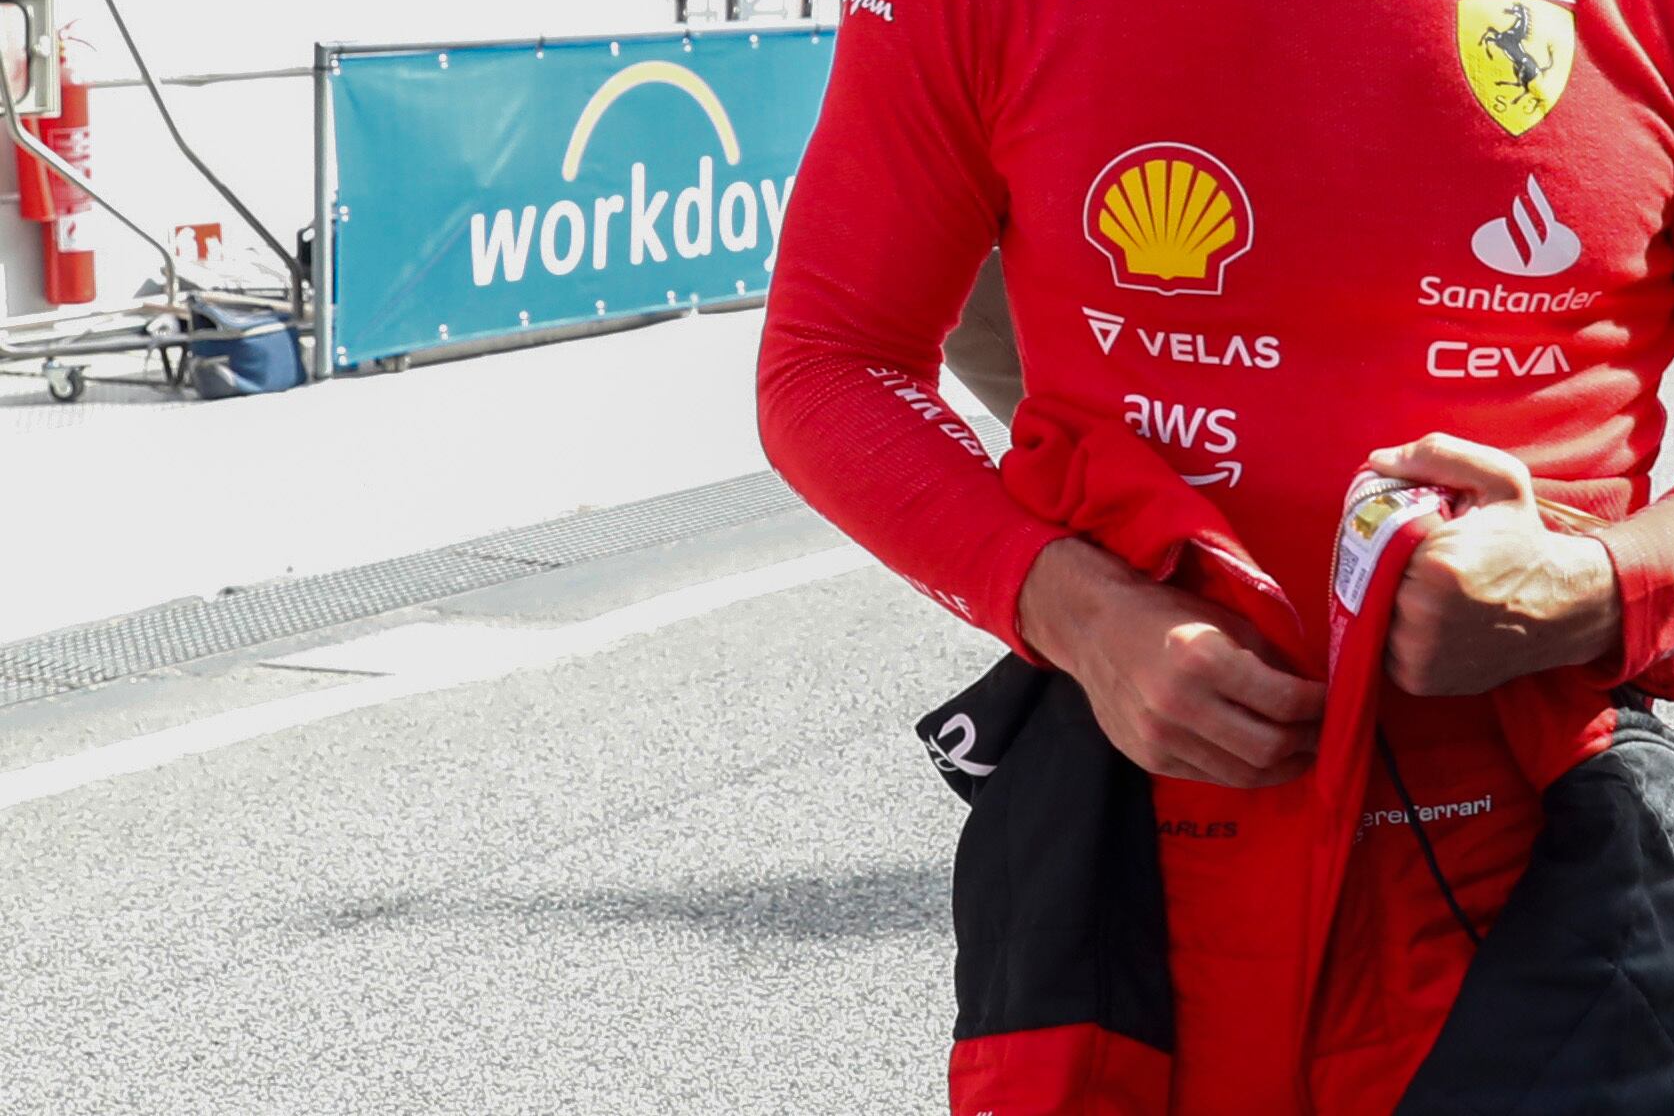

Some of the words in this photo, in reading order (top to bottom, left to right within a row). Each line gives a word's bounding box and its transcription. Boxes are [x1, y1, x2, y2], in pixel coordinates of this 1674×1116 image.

[470, 155, 795, 286] workday
[1418, 276, 1603, 314] Santander
[1137, 329, 1281, 369] VELAS
[1124, 394, 1238, 455] aws
